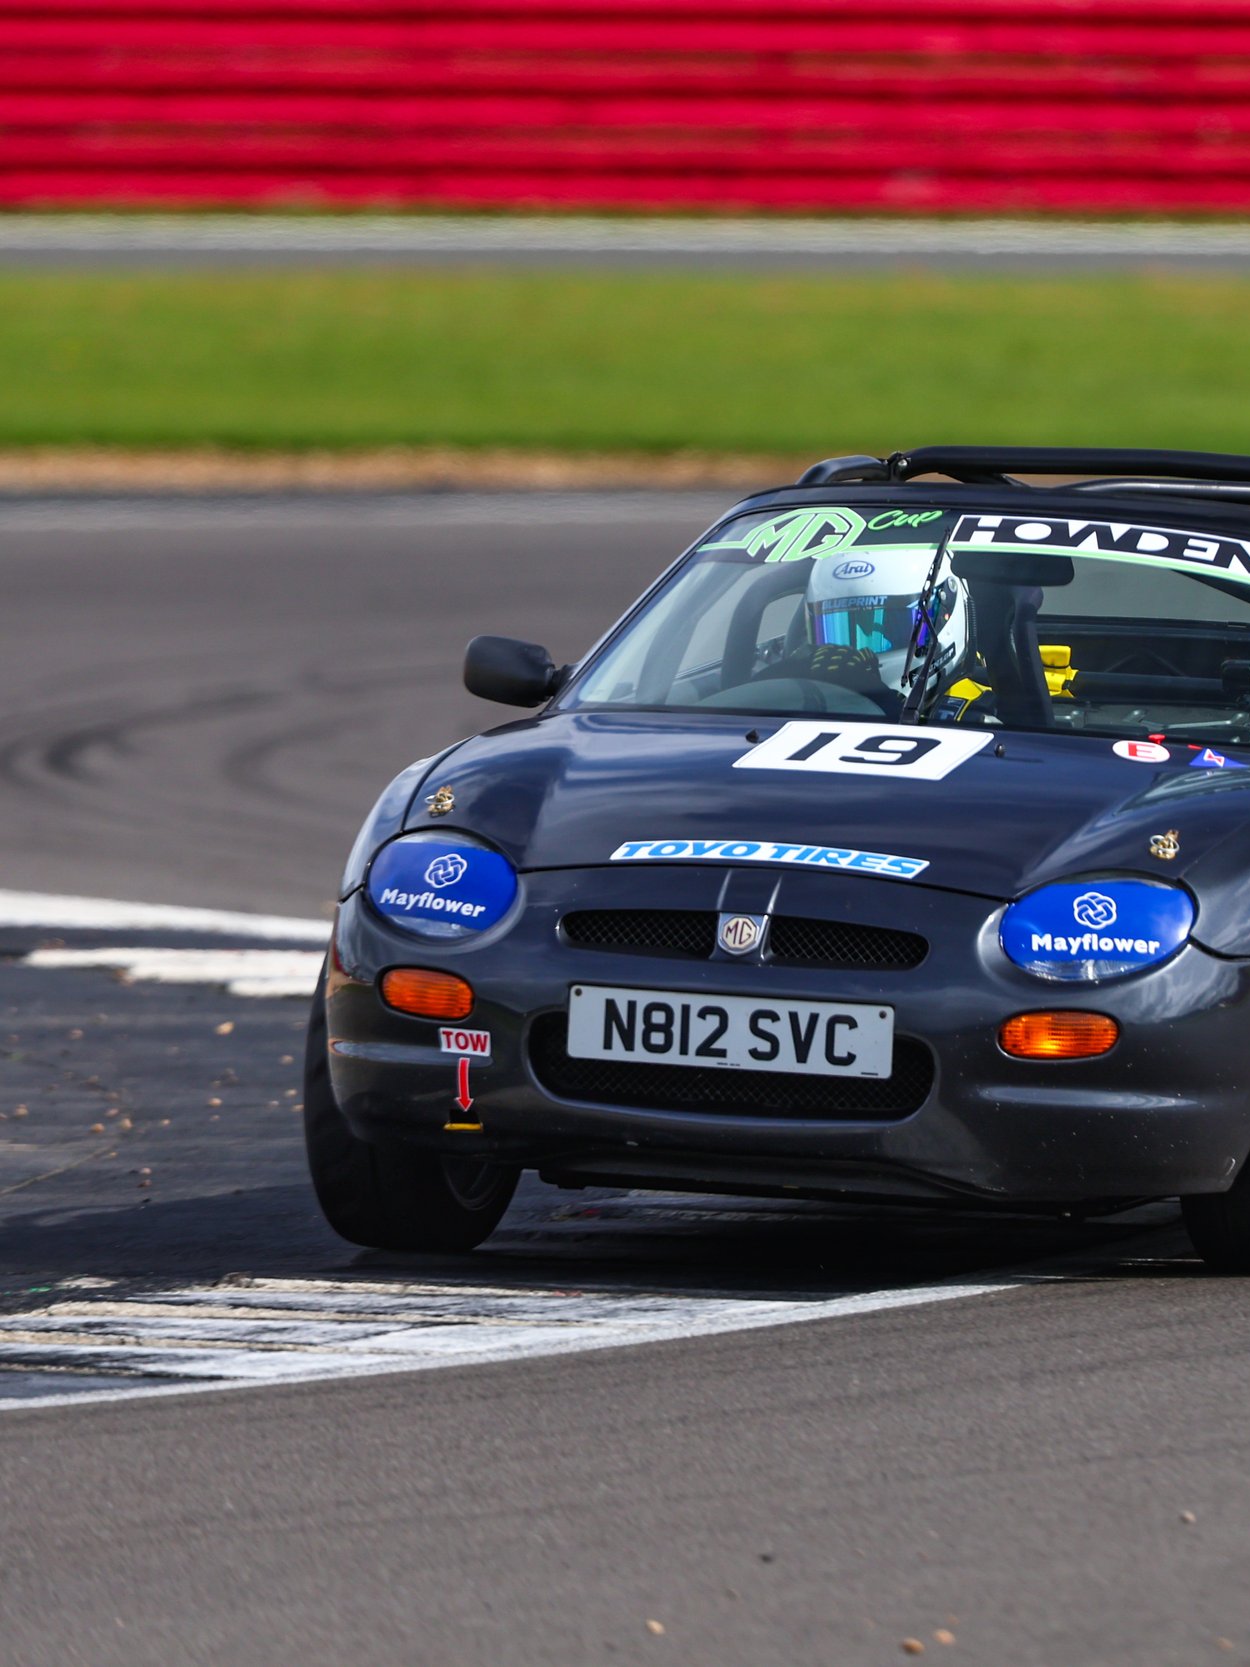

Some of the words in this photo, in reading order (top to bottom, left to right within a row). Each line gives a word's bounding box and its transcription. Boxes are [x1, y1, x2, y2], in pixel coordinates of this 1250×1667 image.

[744, 507, 866, 563] MG
[867, 510, 943, 531] Cup
[838, 562, 871, 577] Arai
[822, 596, 888, 611] BLUEPRINT
[784, 732, 942, 766] 19
[621, 842, 761, 859] TOYO
[766, 845, 922, 875] TIRES
[380, 888, 486, 919] Mayflower
[724, 920, 753, 944] MG
[1031, 933, 1160, 956] Mayflower
[442, 1030, 489, 1053] TOW
[603, 998, 728, 1059] N812
[748, 1009, 858, 1067] SVC
